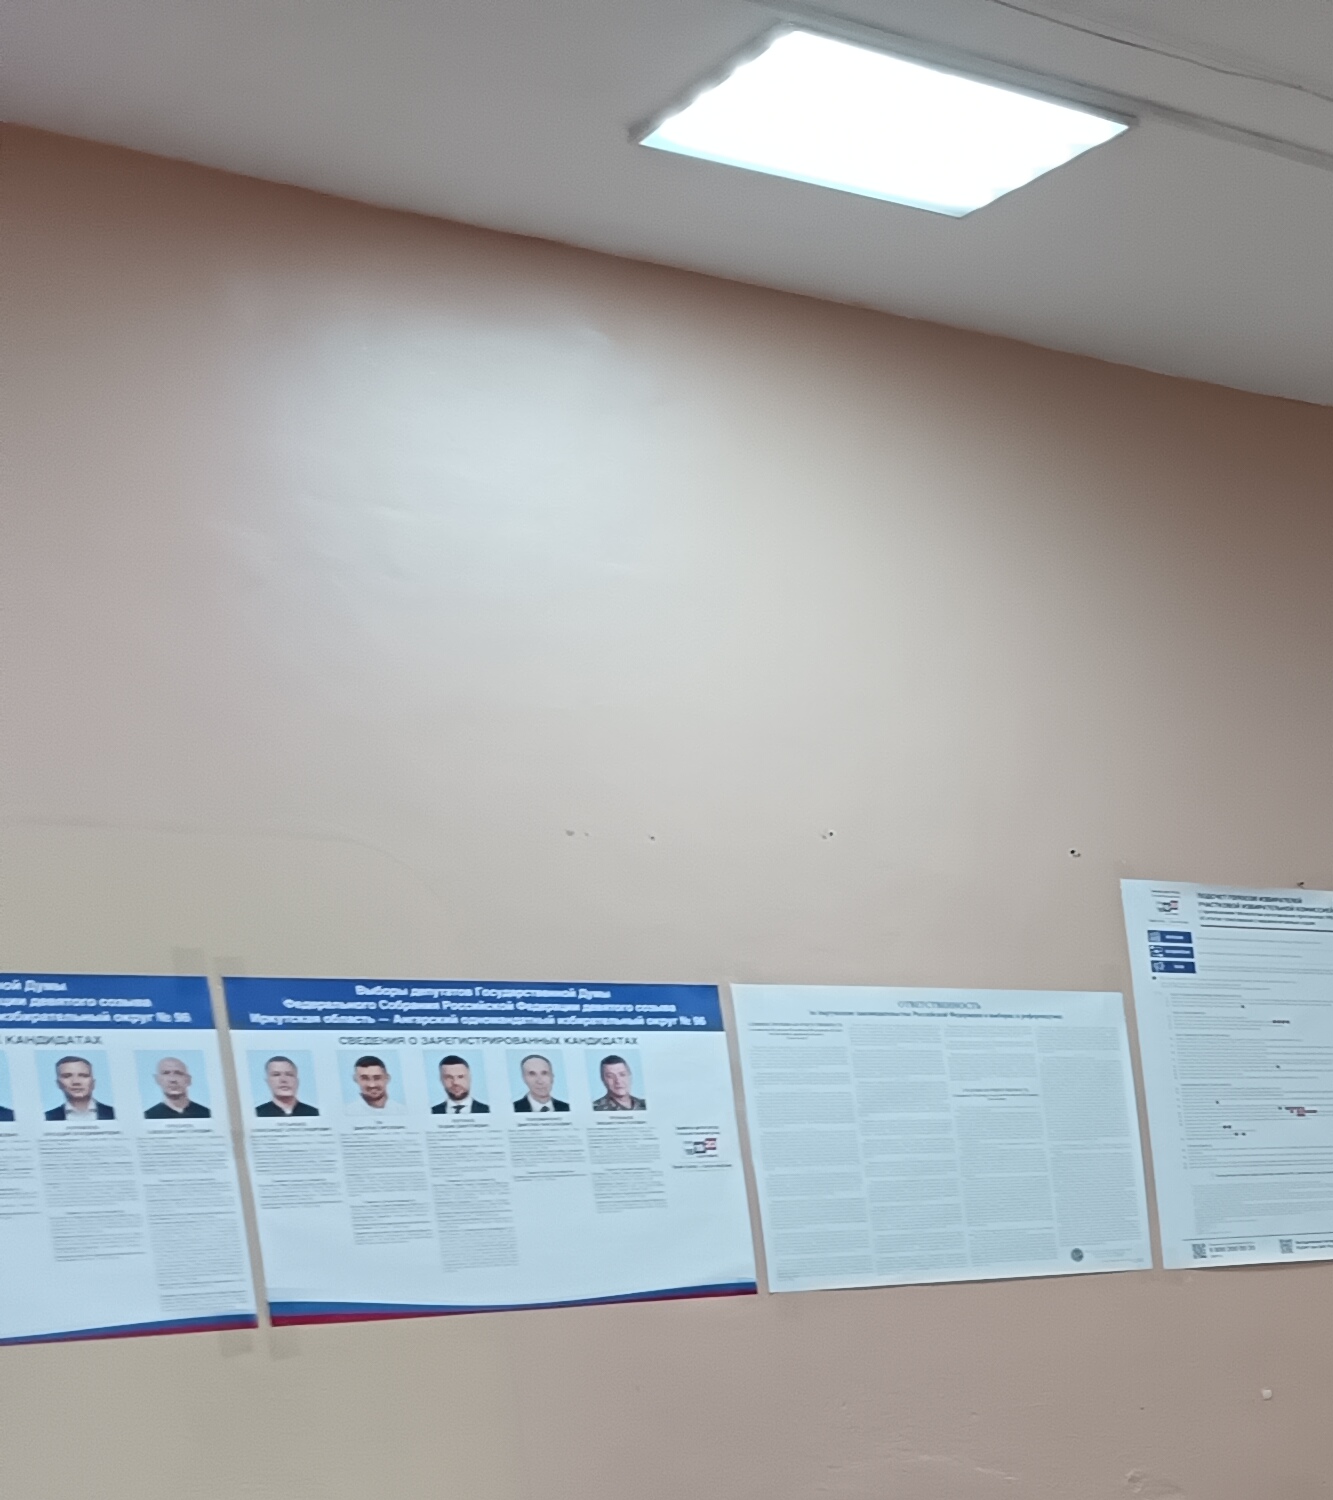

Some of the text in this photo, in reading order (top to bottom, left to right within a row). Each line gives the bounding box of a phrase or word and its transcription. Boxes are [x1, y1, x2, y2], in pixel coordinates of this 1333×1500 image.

[339, 1036, 406, 1046] СВЕДЕНИЯ
[408, 1036, 418, 1046] О
[564, 1036, 639, 1047] КАНДИДАТАХ
